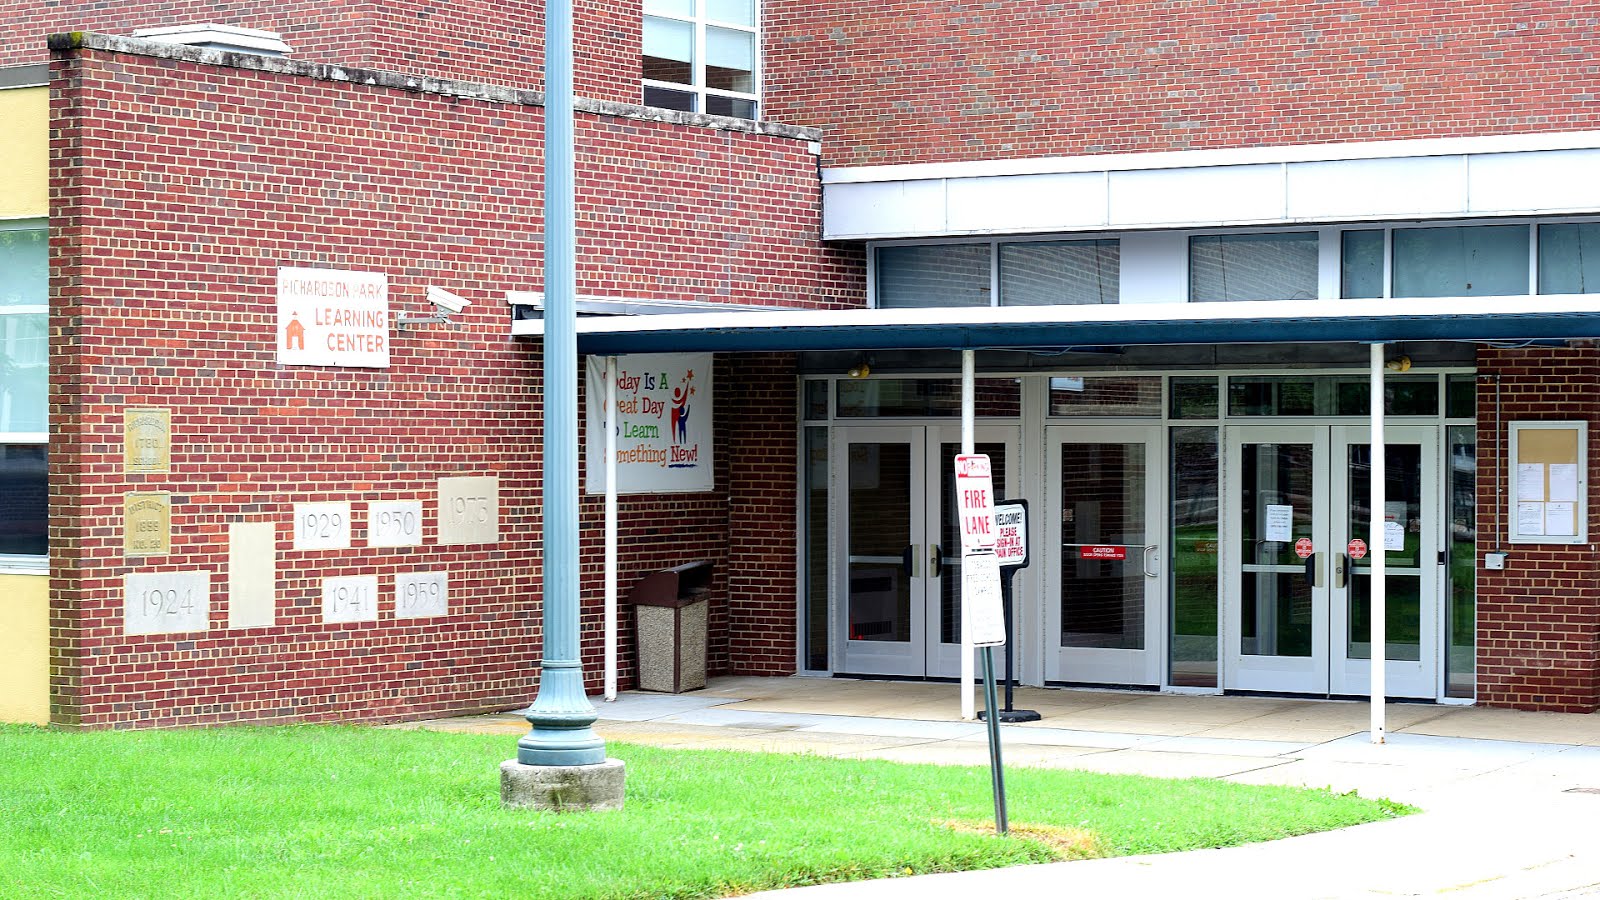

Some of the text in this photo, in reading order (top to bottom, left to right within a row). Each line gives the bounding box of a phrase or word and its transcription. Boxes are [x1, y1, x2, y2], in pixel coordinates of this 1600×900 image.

[315, 307, 384, 329] LEARNING
[327, 332, 384, 353] CENTER
[643, 372, 655, 390] Is
[659, 372, 669, 390] A
[642, 397, 665, 419] Day
[623, 421, 659, 439] Learn
[670, 444, 698, 463] New!
[964, 489, 988, 509] FIRE
[301, 513, 342, 539] 1929
[375, 511, 415, 537] 1950
[966, 515, 991, 535] LANE
[1000, 527, 1017, 537] PLEASE
[1008, 546, 1023, 557] OFFICE
[141, 589, 195, 620] 1924
[332, 586, 369, 614] 1941
[402, 582, 440, 610] 1959
